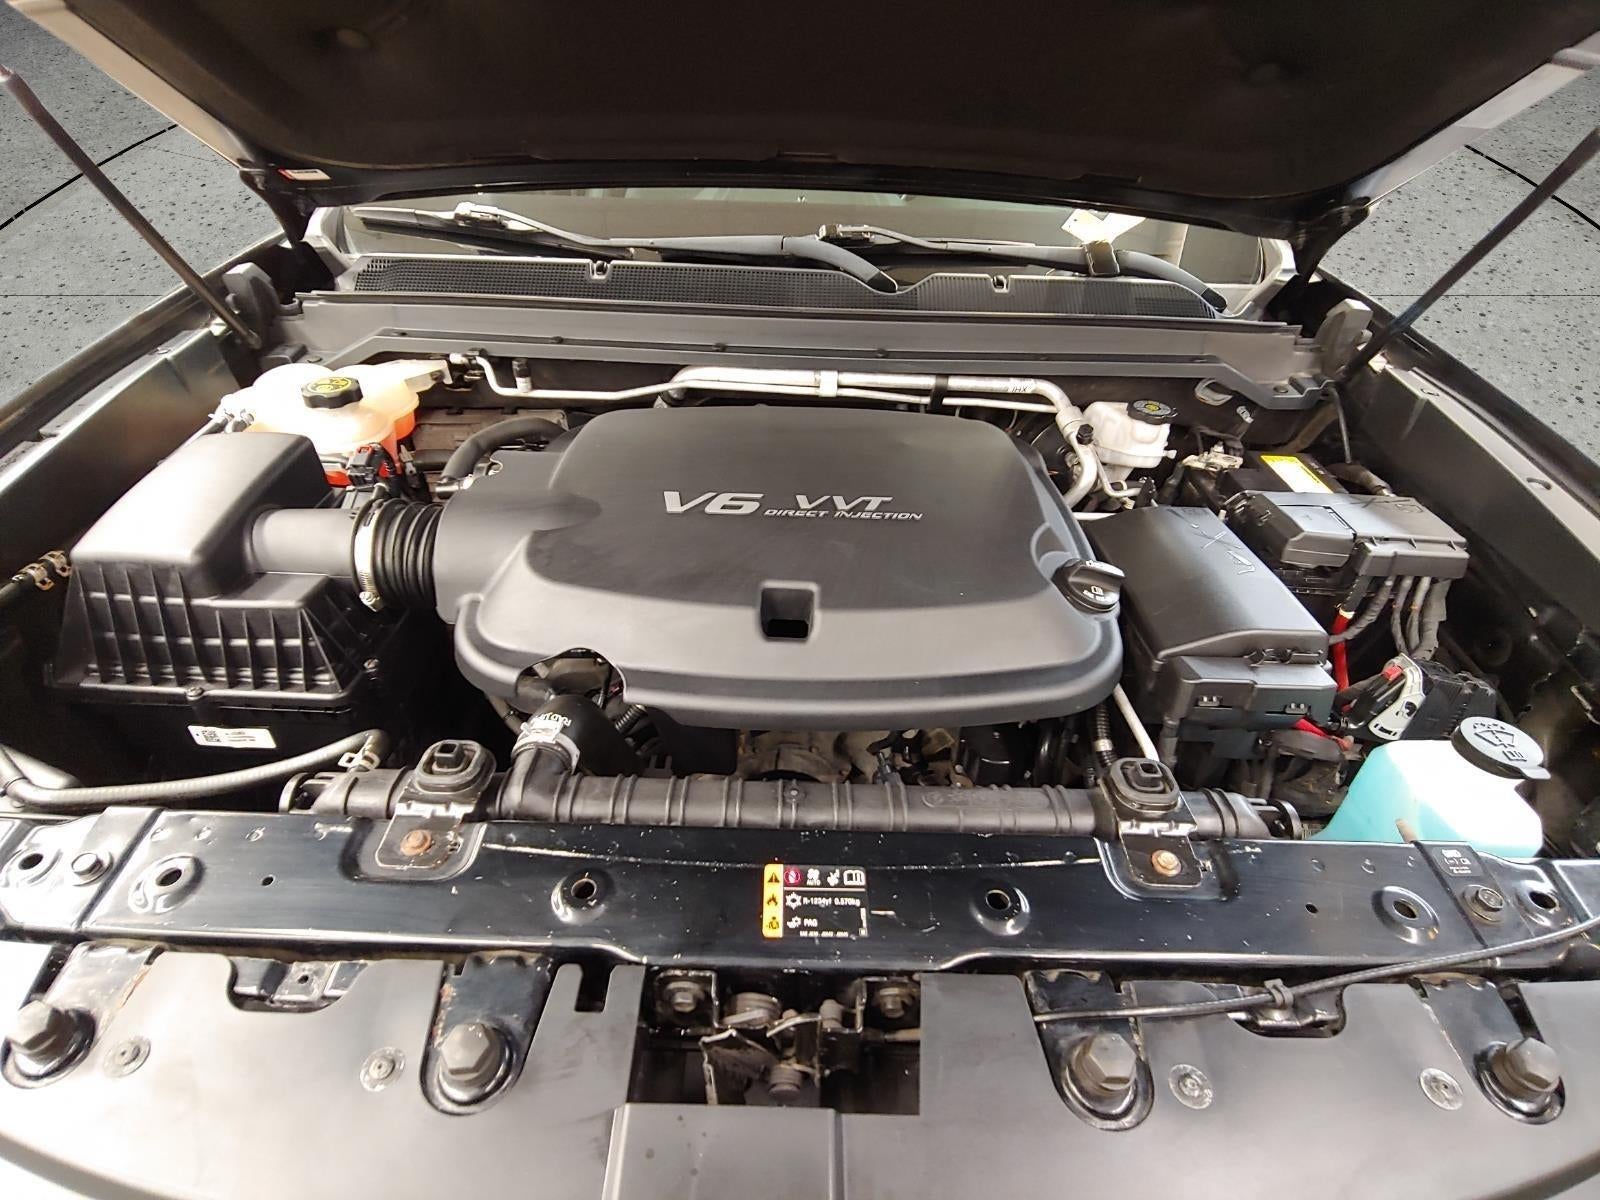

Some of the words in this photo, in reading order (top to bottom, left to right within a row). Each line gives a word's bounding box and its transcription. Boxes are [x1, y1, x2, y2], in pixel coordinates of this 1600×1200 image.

[663, 490, 764, 515] V6
[795, 494, 893, 512] VVT
[764, 508, 829, 518] DIRECT
[833, 510, 923, 521] INJECTION
